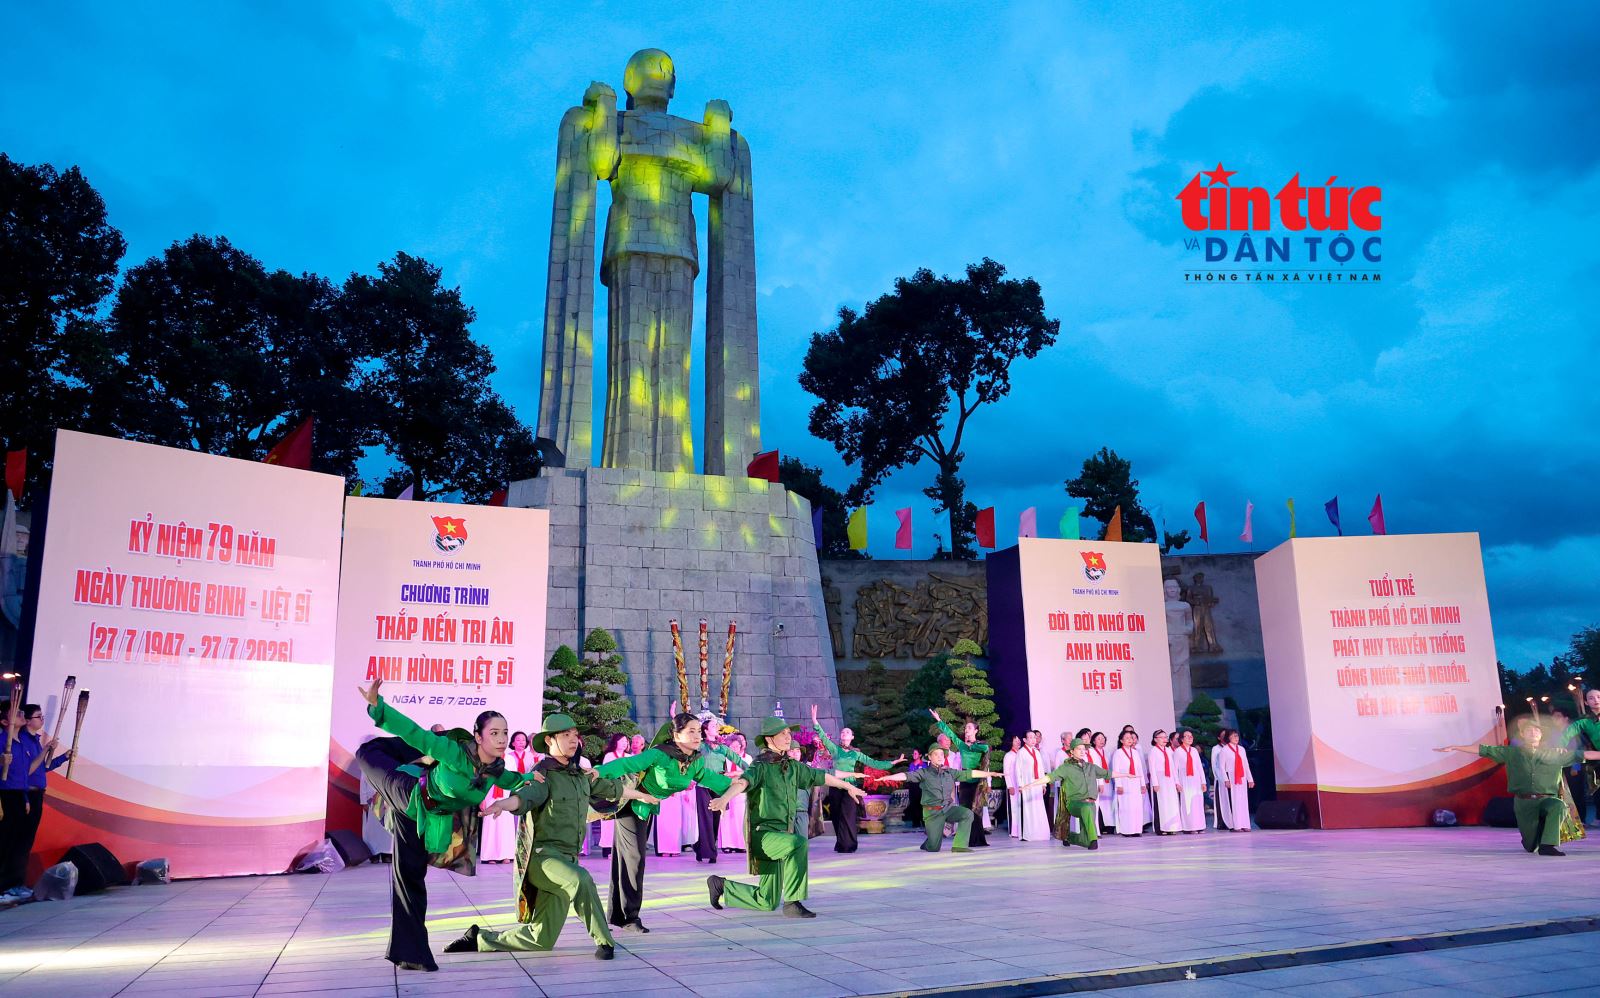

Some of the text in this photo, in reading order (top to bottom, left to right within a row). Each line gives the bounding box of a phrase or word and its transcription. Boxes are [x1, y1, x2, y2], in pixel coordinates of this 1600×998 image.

[129, 512, 276, 568] KỶ NIỆM 79 NĂM
[466, 563, 481, 571] MINH
[401, 583, 489, 606] CHƯƠNG TRÌNH
[1369, 572, 1416, 597] TUỔI TRẺ
[74, 567, 127, 605] NGÀY
[131, 575, 202, 613] THƯƠNG
[204, 583, 246, 617] BINH
[261, 586, 291, 628] LIỆT
[295, 589, 312, 623] SĨ
[376, 607, 514, 645] THẮP NẾN TRI ÂN
[1048, 610, 1146, 632] ĐỜI ĐỜI NHỚ ƠN
[1330, 602, 1461, 627] THÀNH PHỐ HỒ CHÍ MINH
[1066, 643, 1093, 660] ANH
[1333, 630, 1466, 656] PHÁT HUY TRUYỀN THỐNG
[365, 653, 515, 690] ANH HÙNG, LIỆT SĨ
[1082, 669, 1123, 695] LIỆT SĨ
[1337, 663, 1368, 687] UỐNG
[391, 695, 488, 706] NGÀY 26/7/2026
